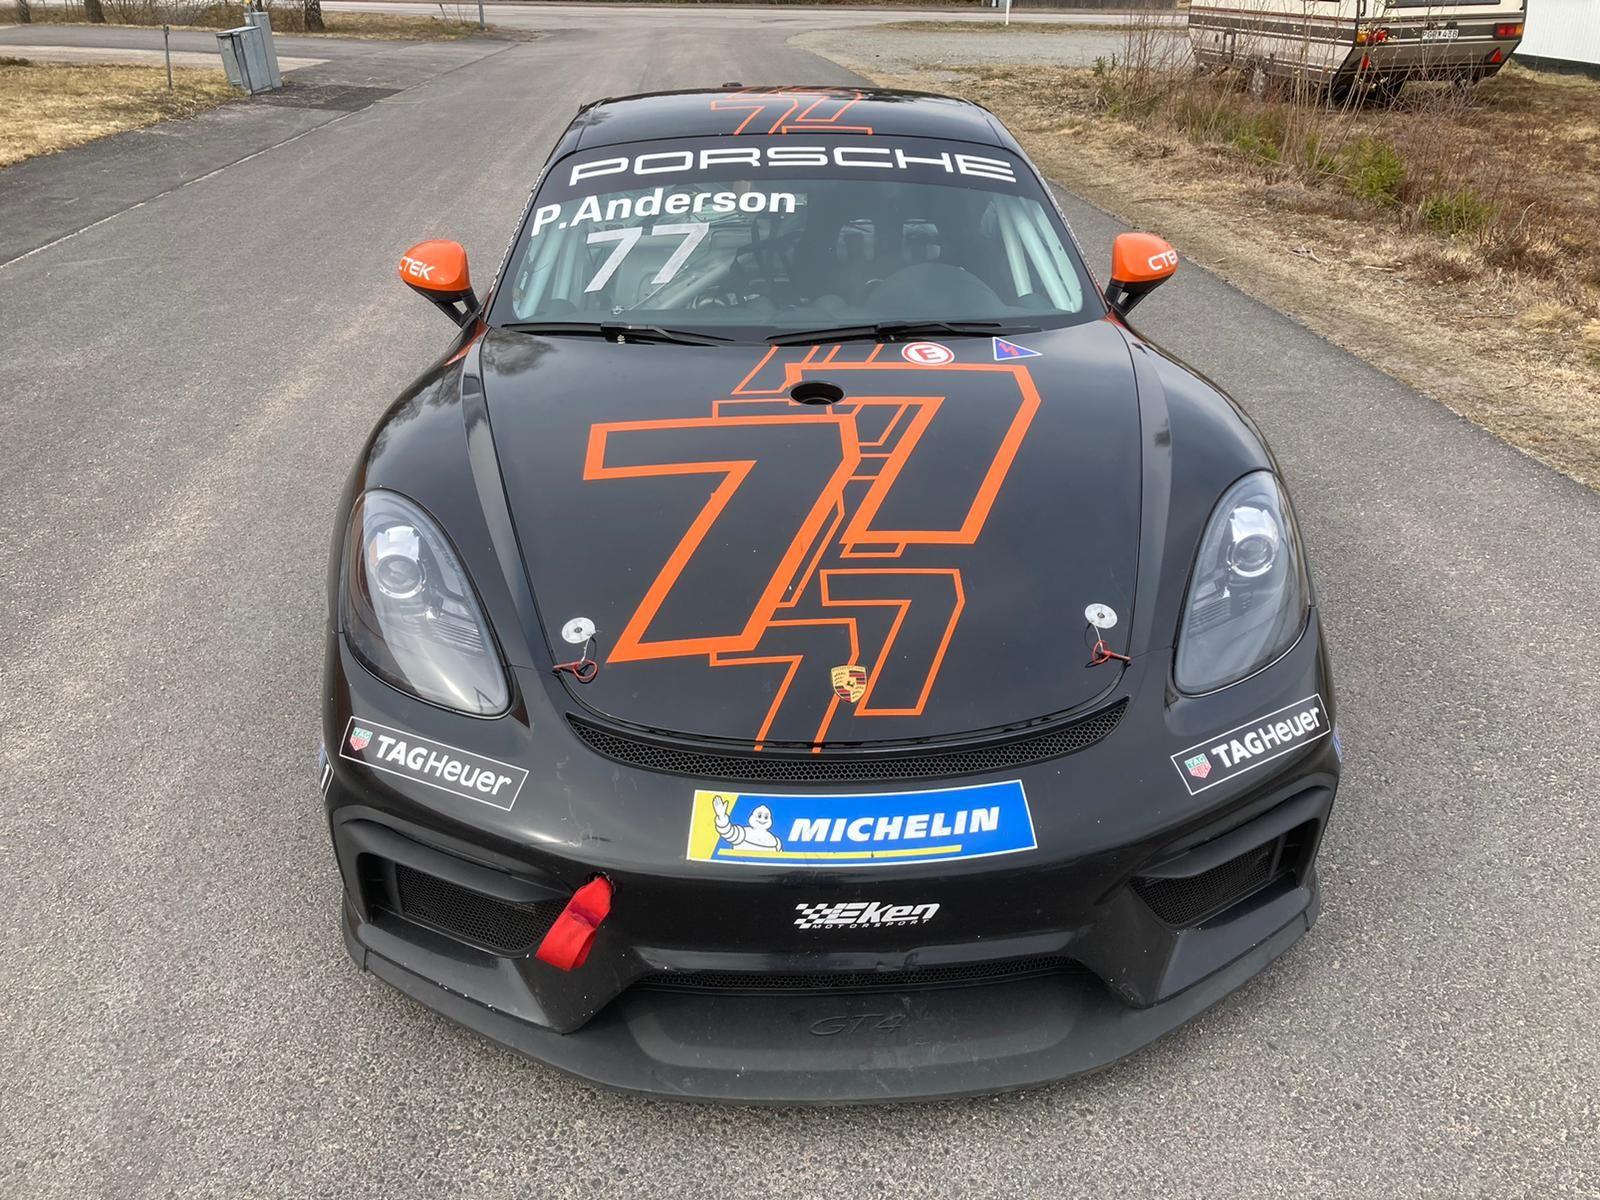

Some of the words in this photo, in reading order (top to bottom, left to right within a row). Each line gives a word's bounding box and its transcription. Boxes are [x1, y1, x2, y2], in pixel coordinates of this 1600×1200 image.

[568, 146, 1017, 187] PORSCHE
[531, 187, 796, 237] P.Anderson
[583, 222, 710, 293] 77
[1148, 250, 1178, 270] CTE
[914, 347, 942, 361] E
[787, 806, 1000, 842] MICHELIN
[811, 918, 930, 929] MOTORSPORT
